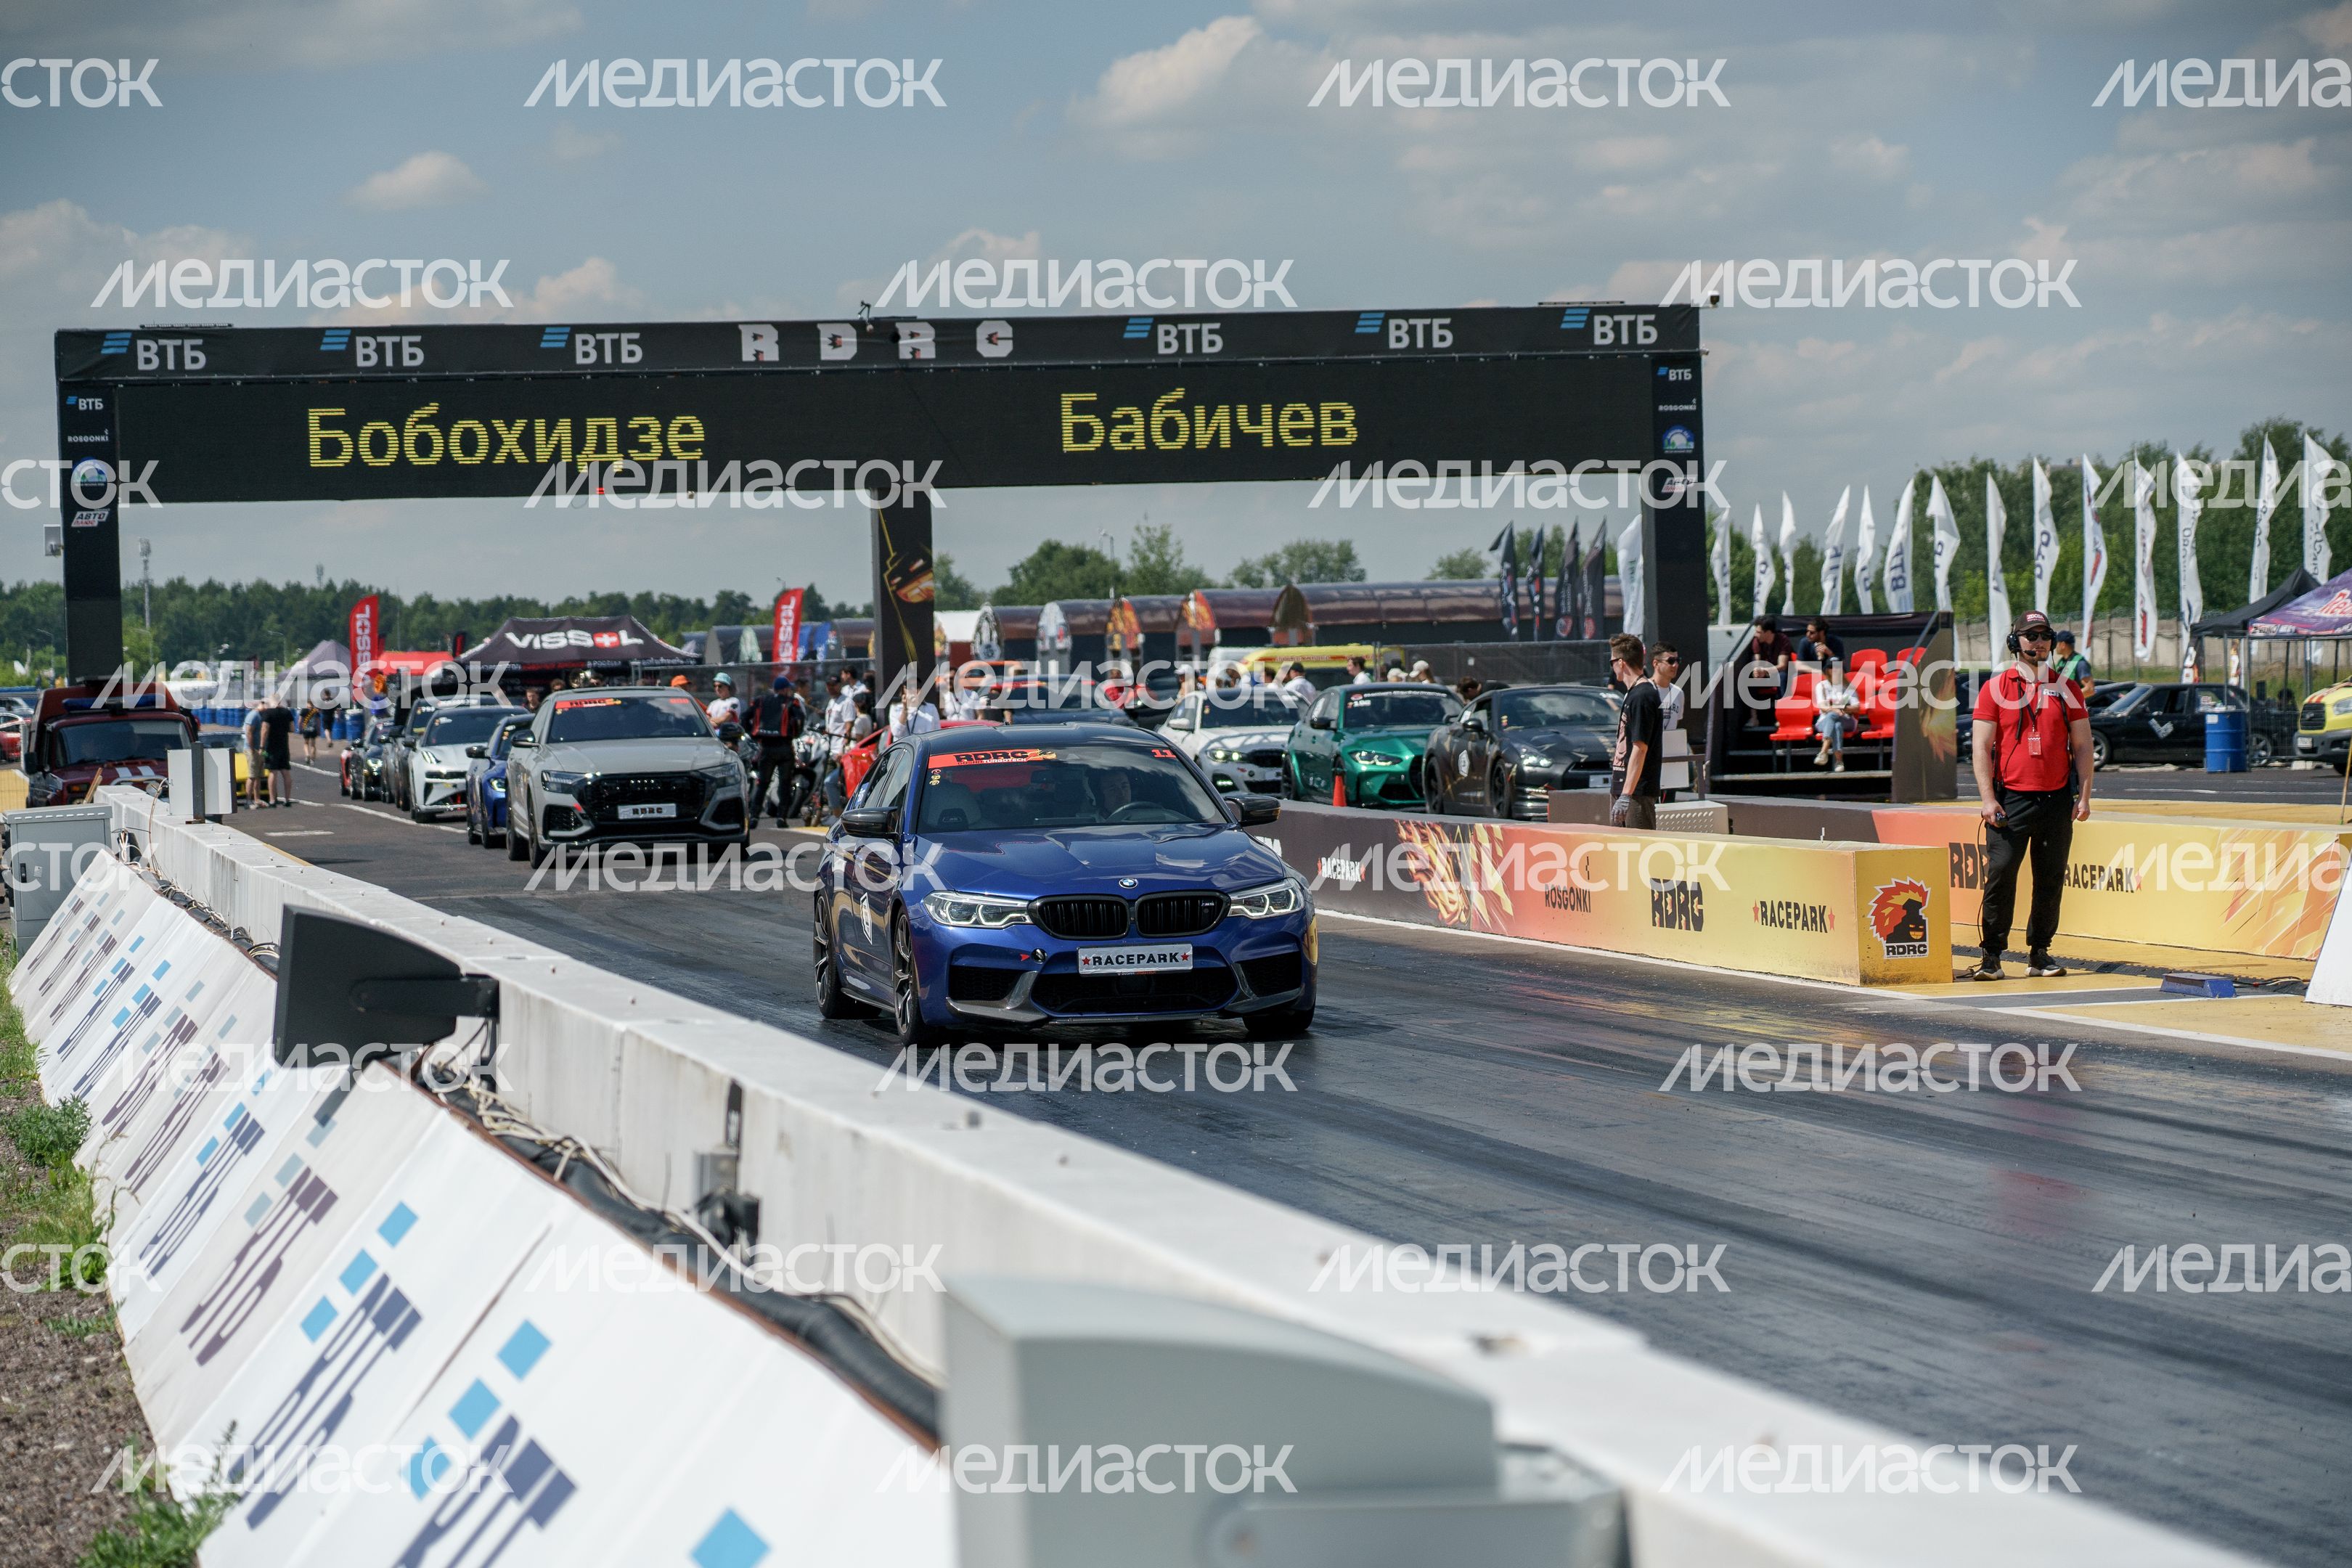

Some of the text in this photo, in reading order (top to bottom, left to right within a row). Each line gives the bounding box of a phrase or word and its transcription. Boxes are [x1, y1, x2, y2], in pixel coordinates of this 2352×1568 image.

[1157, 322, 1224, 354] ВТБ
[1388, 317, 1453, 349] ВТБ
[1593, 314, 1659, 345] ВТБ
[136, 339, 206, 371] ВТБ
[355, 335, 425, 367] ВТБ
[575, 332, 643, 364] ВТБ
[1668, 368, 1693, 381] ВТБ
[78, 399, 104, 411] ВТБ
[1060, 387, 1359, 453] Бабичев
[308, 402, 705, 473] Бобохидзе
[1544, 883, 1591, 913] ROSGONKI
[1649, 878, 1704, 932] RDRC
[1760, 899, 1829, 934] RACEPARK
[1092, 952, 1180, 966] RACEPARK
[1885, 944, 1927, 956] RDRC
